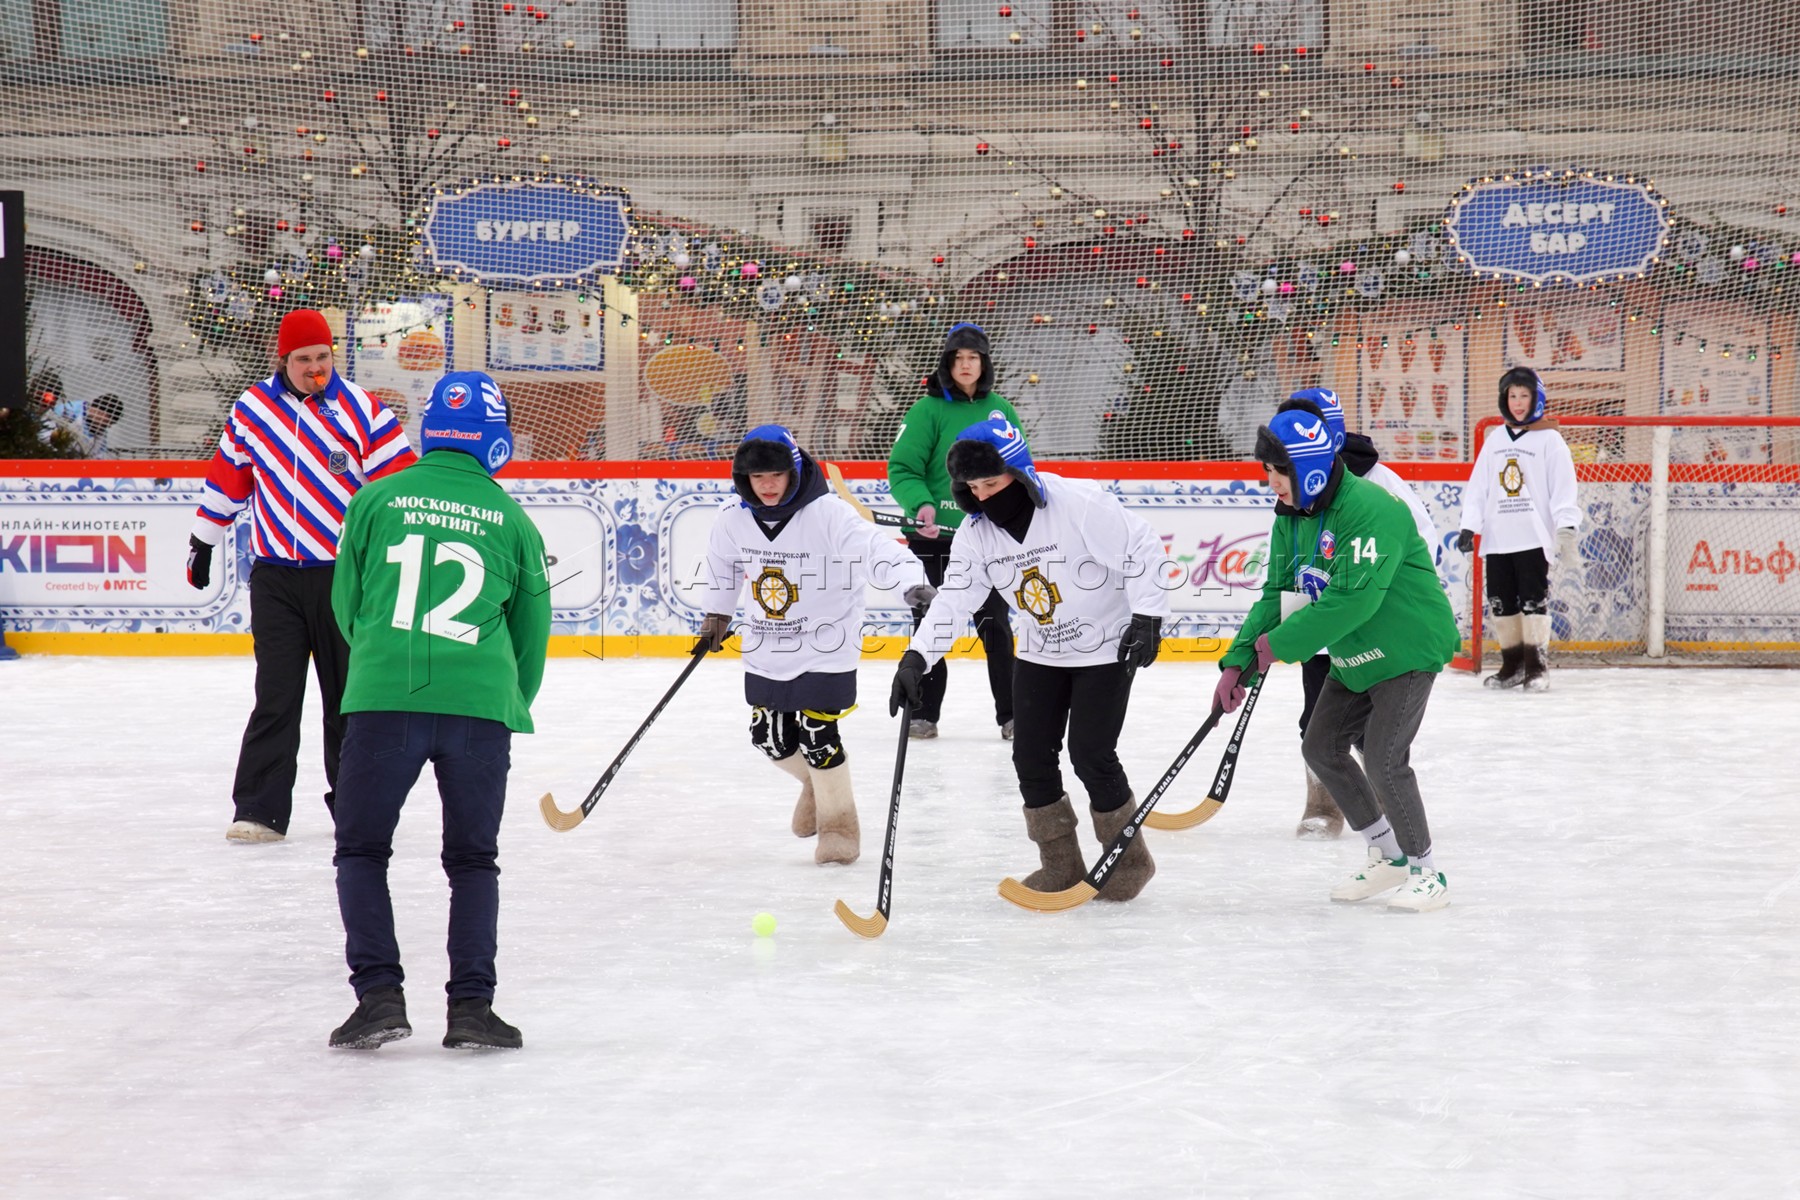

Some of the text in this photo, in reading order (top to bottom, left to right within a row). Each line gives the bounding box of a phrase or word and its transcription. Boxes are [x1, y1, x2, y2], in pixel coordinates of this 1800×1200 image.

[1502, 203, 1616, 228] ДЕСЕРТ
[476, 220, 580, 243] БУРГЕР
[1530, 231, 1586, 254] БАР
[1, 517, 147, 530] НЛАЙН-КИНОТЕАТР
[387, 495, 504, 526] «МОСКОВСКИЙ
[875, 512, 901, 523] STEX
[403, 511, 487, 537] МУФТИЯТ»
[0, 534, 146, 573] KION
[1350, 536, 1378, 565] 14
[1686, 540, 1800, 584] Альф
[45, 581, 85, 591] Created
[87, 582, 100, 592] by
[386, 533, 485, 645] 12
[1344, 647, 1386, 668] ХОККЕЙ
[1214, 693, 1257, 797] STEX ORANGE HAIL
[1094, 773, 1174, 884] STEX ORANGE HAIL
